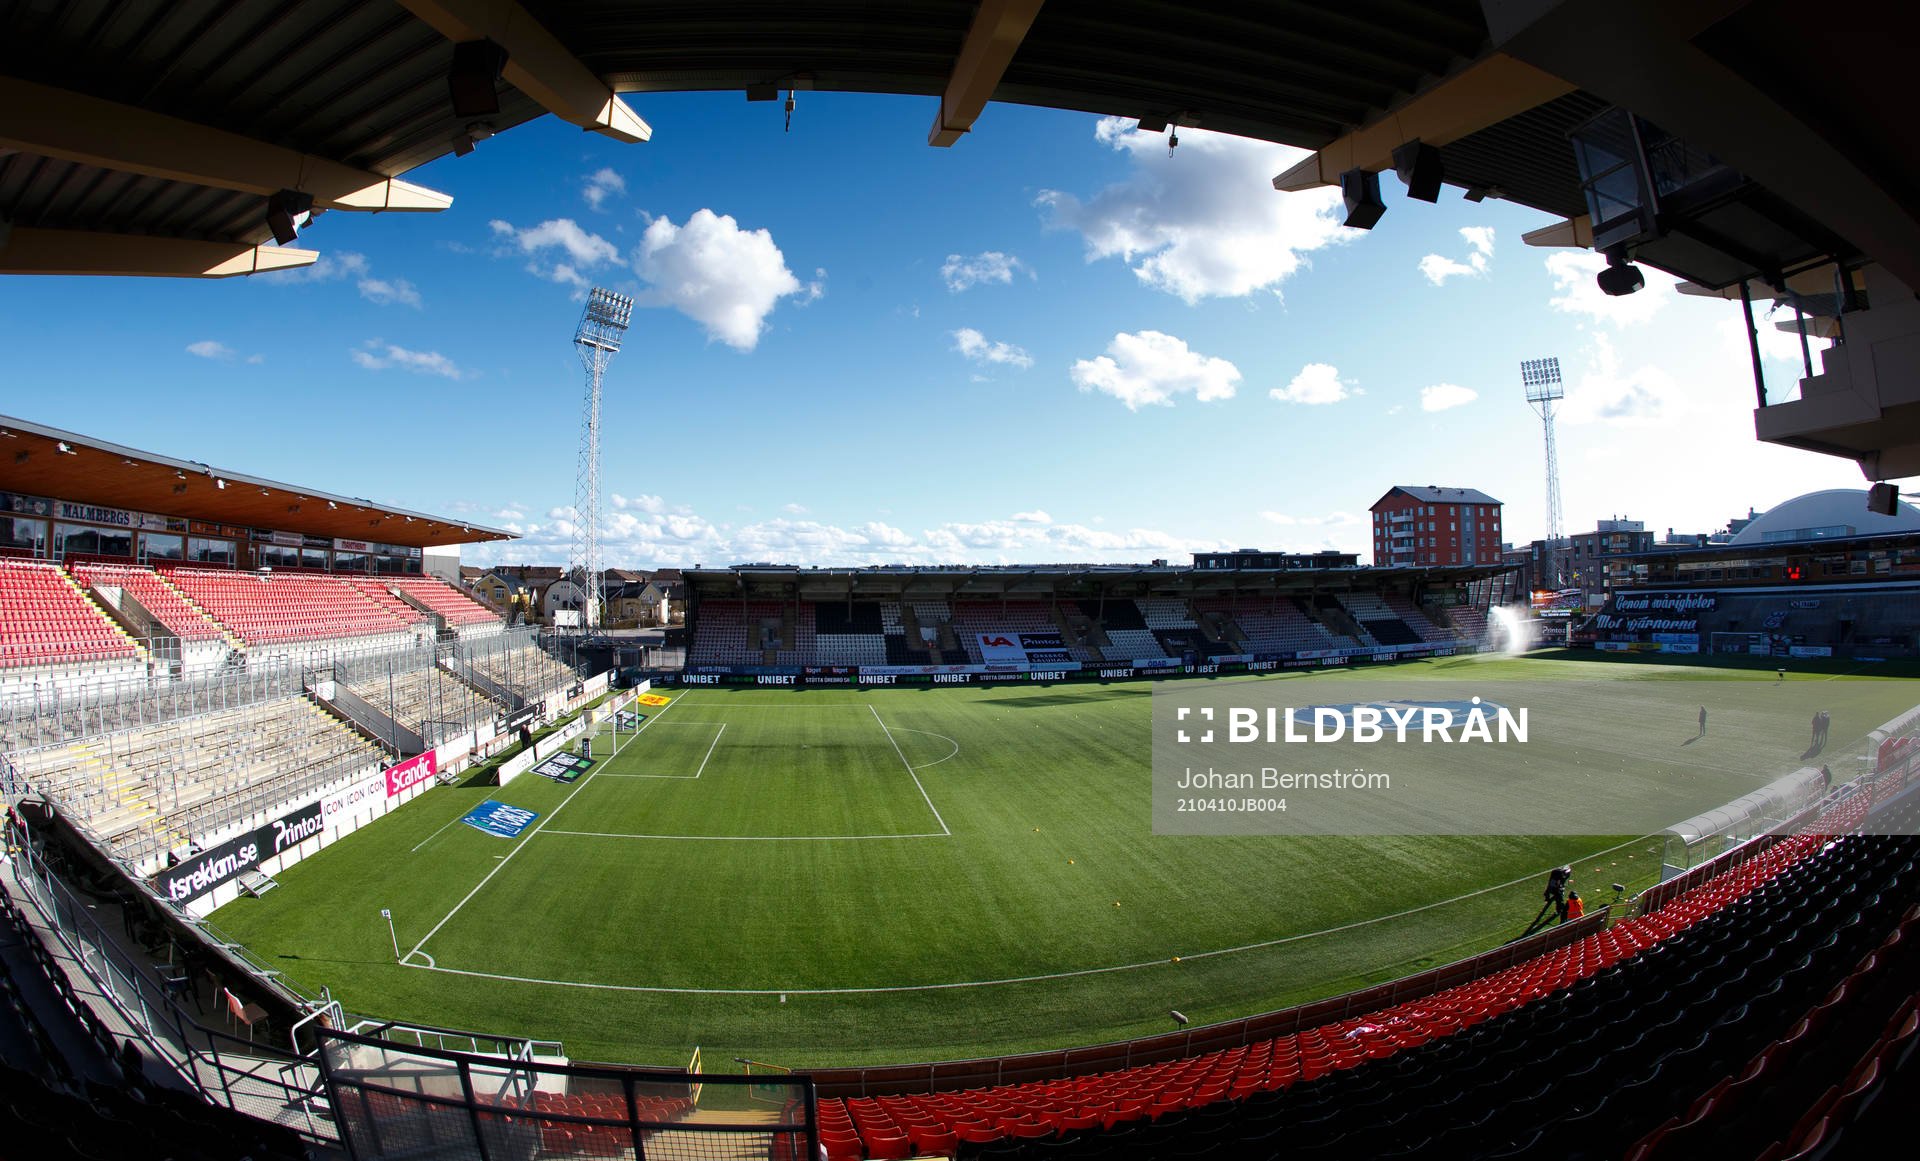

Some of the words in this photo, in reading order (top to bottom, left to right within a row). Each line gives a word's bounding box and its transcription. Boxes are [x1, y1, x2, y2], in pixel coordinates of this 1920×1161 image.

[63, 503, 130, 525] MALMBERGS
[1321, 656, 1349, 666] UNIBET
[1373, 653, 1398, 662] UNIBET
[1247, 661, 1278, 671] UNIBET
[933, 673, 972, 683] UNIBET
[1030, 671, 1067, 681] UNIBET
[1100, 668, 1135, 678] UNIBET
[682, 675, 720, 684] UNIBET
[757, 675, 797, 684] UNIBET
[859, 675, 897, 684] UNIBET
[391, 757, 431, 792] Scandic
[324, 800, 344, 817] ICON
[346, 789, 365, 805] ICON
[367, 778, 385, 796] ICON
[272, 813, 323, 854] Printoz
[169, 842, 258, 901] tsreklam.se
